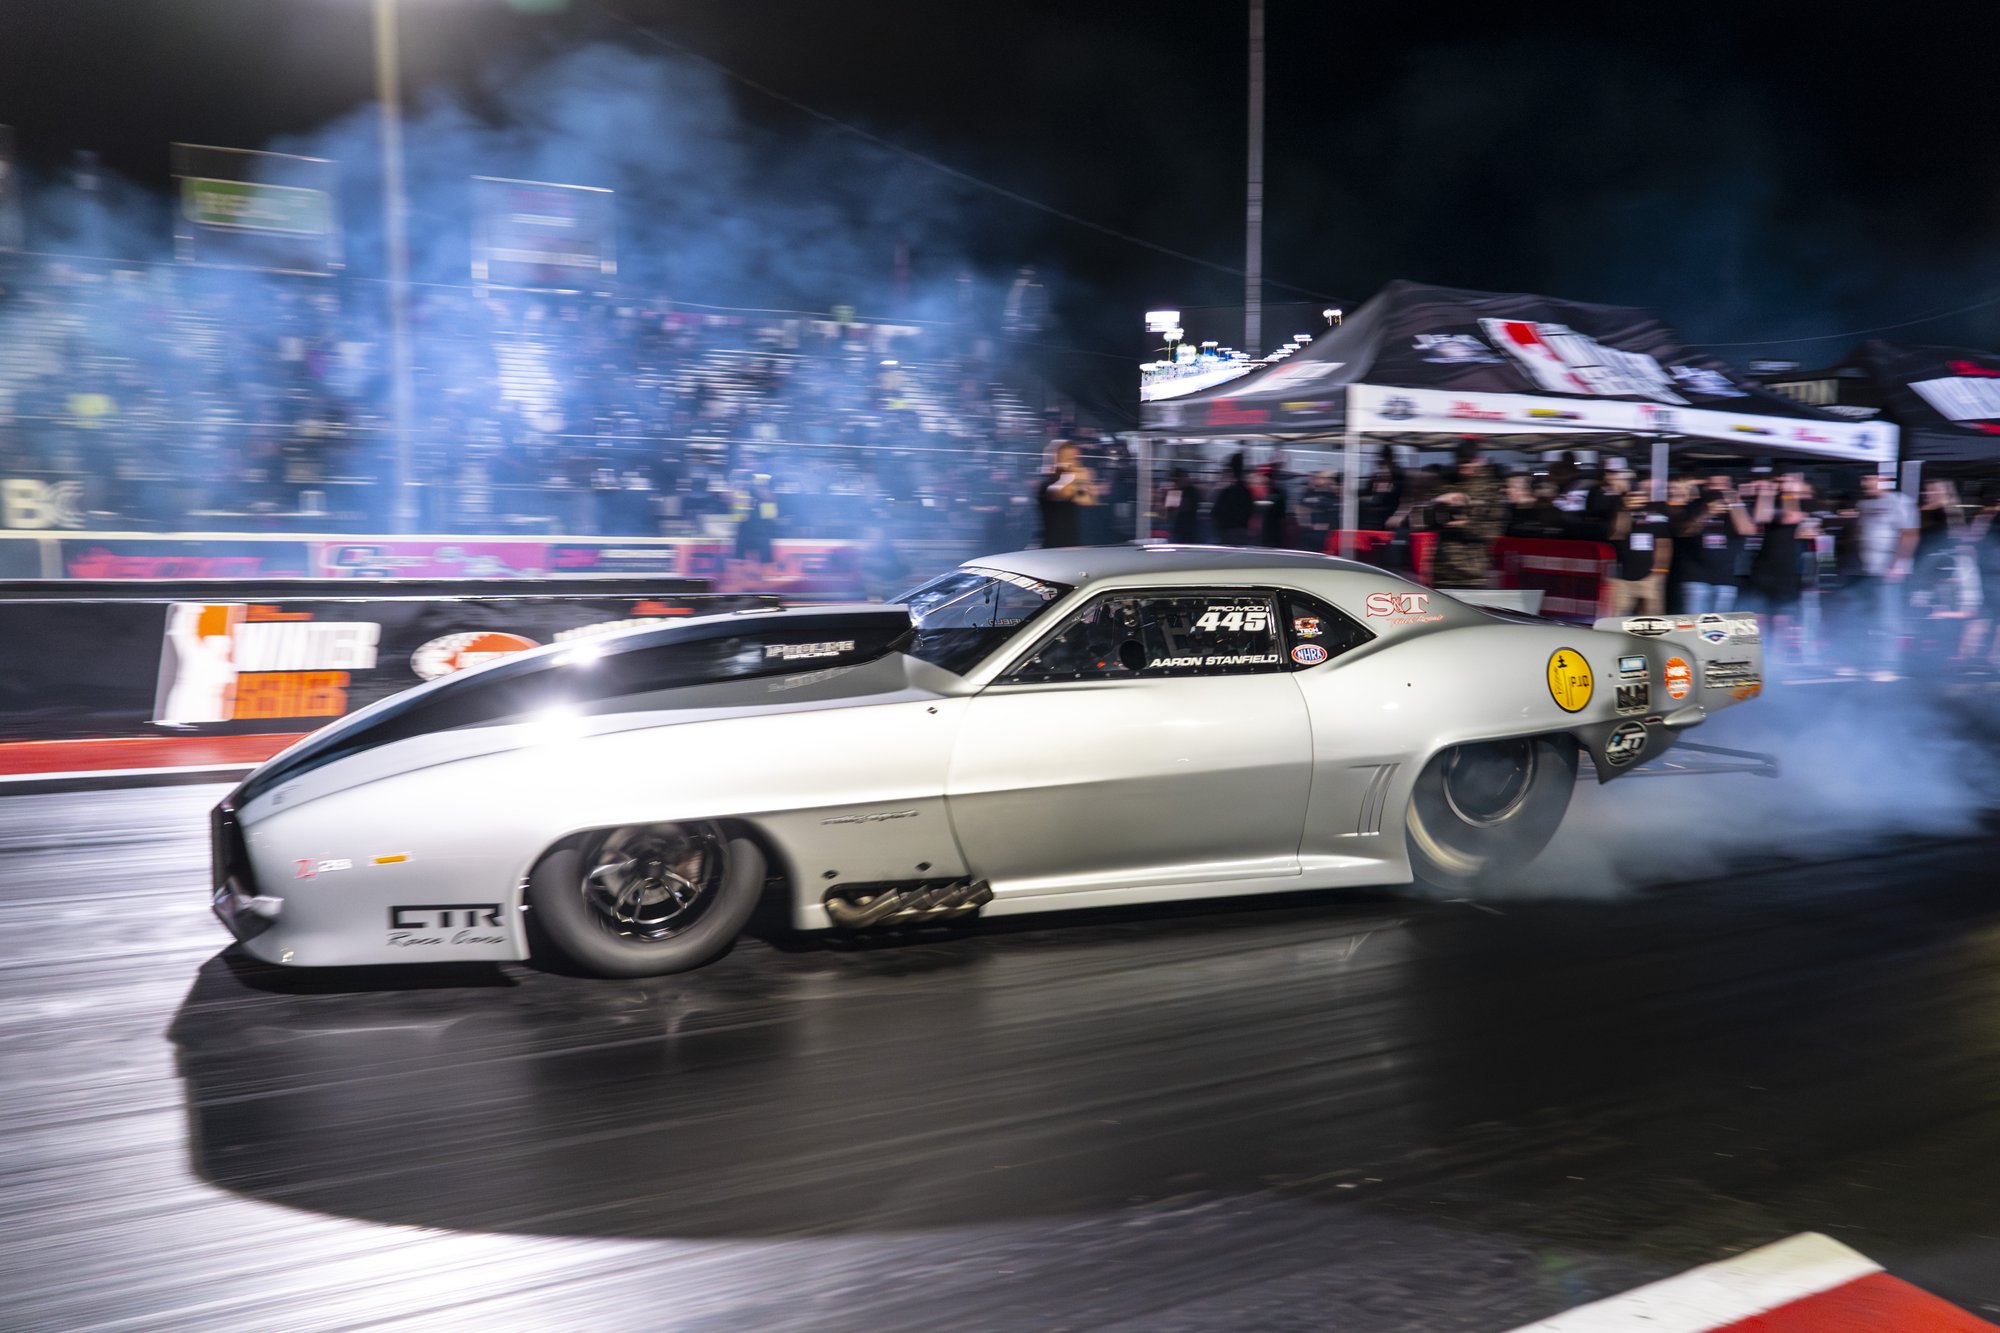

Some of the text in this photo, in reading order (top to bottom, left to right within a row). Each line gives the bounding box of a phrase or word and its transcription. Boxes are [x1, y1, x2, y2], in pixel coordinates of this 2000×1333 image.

[1366, 592, 1429, 617] S&T
[1195, 612, 1267, 631] 445
[1150, 654, 1278, 668] AARON STANFIELD
[1296, 648, 1324, 660] NHRA
[387, 903, 504, 929] CTR
